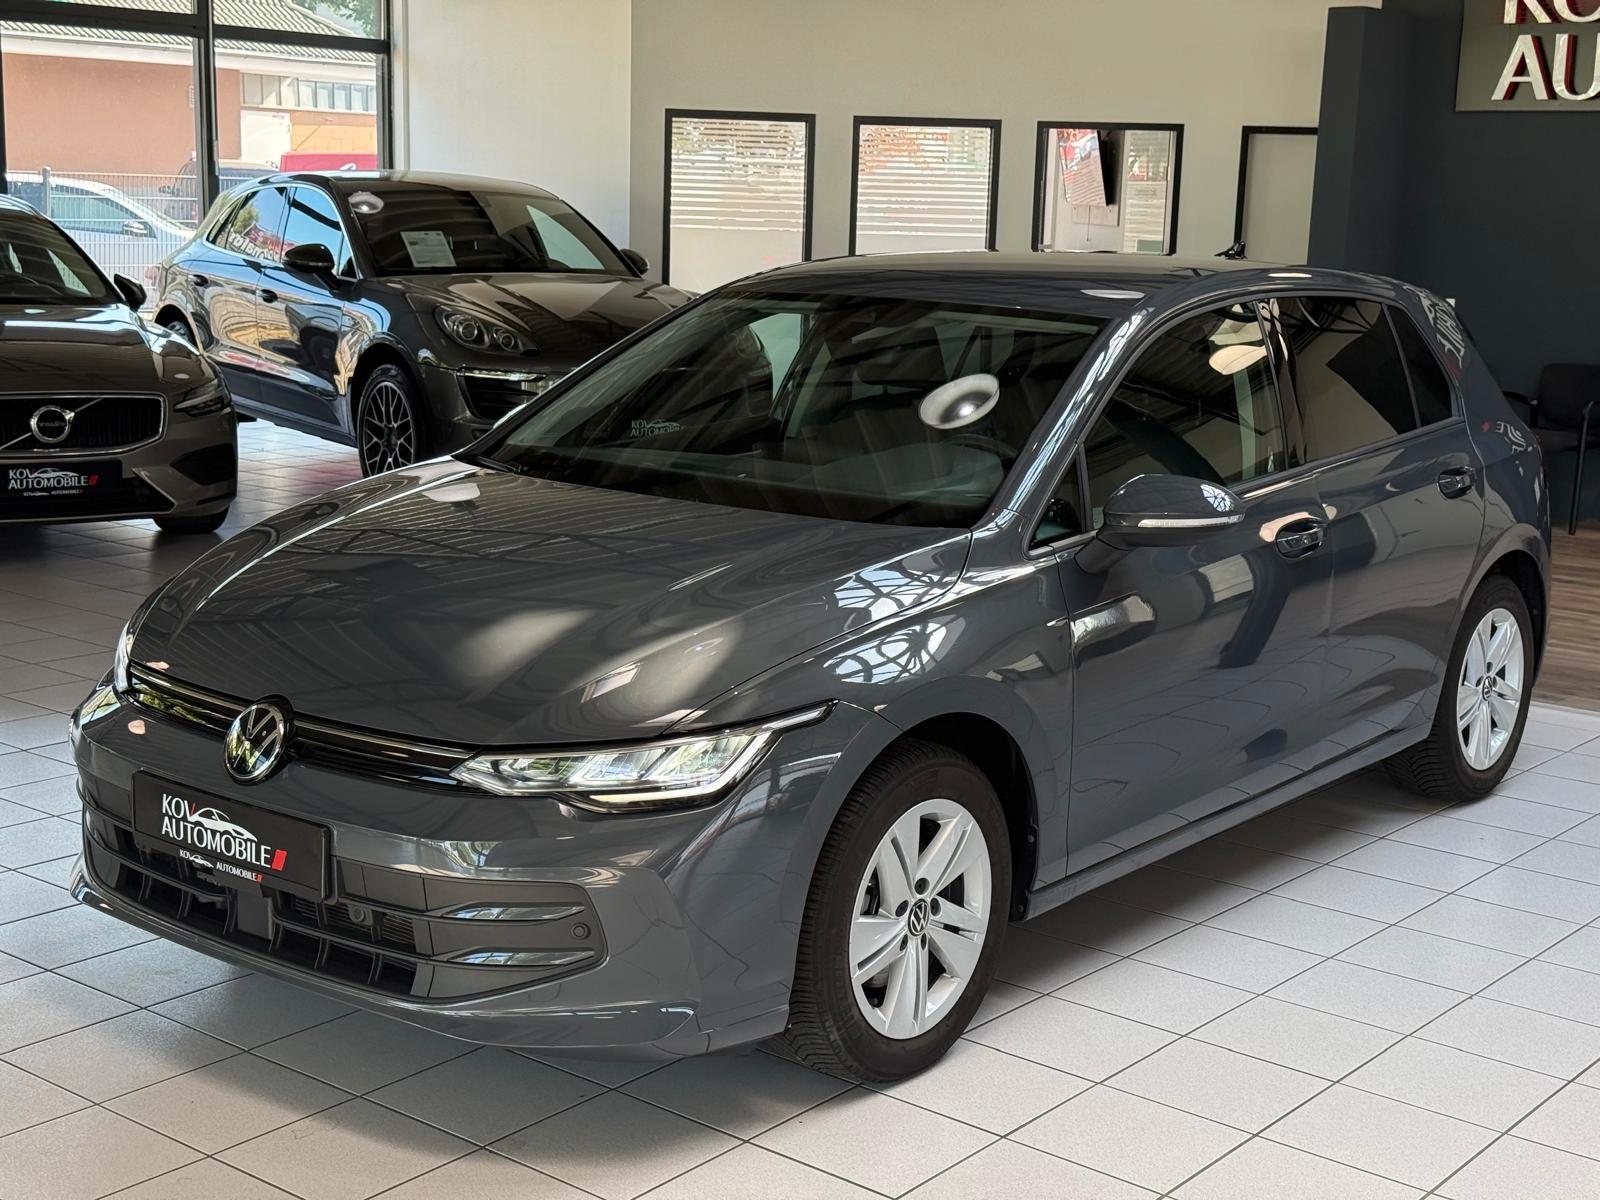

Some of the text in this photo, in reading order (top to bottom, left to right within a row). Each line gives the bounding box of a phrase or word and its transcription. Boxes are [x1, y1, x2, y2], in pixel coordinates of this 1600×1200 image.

[8, 468, 34, 479] KOV
[8, 475, 89, 490] AUTOMOBILE
[162, 793, 196, 822] KOV
[162, 816, 272, 868] AUTOMOBILE
[179, 849, 257, 882] KOV AUTOMOBILE
